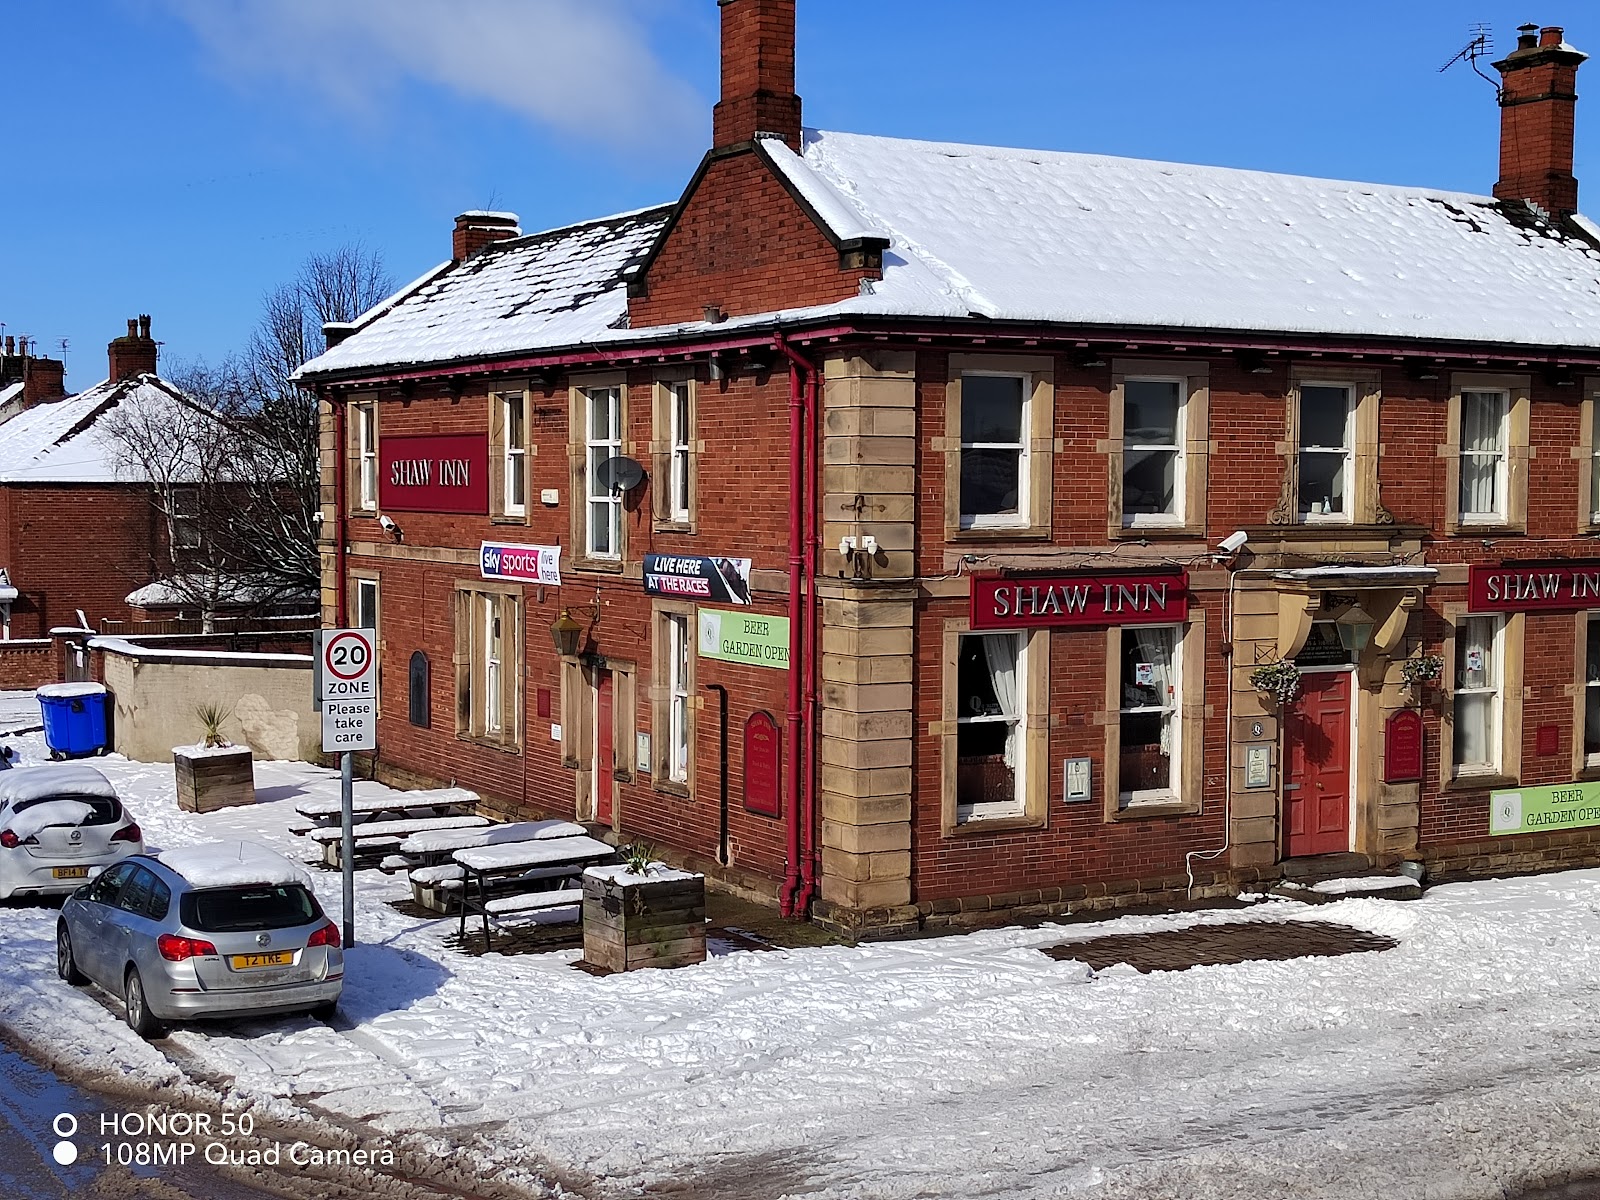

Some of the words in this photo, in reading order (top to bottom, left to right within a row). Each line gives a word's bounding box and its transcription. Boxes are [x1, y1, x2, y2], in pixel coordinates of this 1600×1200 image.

[391, 459, 433, 486] SHAW
[438, 459, 470, 487] INN
[484, 549, 500, 573] sky
[502, 553, 536, 574] sports
[541, 550, 554, 565] live
[541, 567, 558, 581] here
[653, 557, 676, 573] LIVE
[676, 559, 702, 575] HERE
[648, 576, 660, 589] AT
[661, 577, 679, 591] THE
[679, 579, 709, 594] RACES
[1487, 573, 1562, 600] SHAW
[994, 585, 1091, 616] SHAW
[1102, 582, 1168, 612] INN
[743, 620, 769, 636] BEER
[334, 645, 365, 666] 20
[723, 640, 762, 658] GARDEN
[764, 645, 790, 661] OPEN
[328, 682, 370, 694] ZONE
[328, 704, 370, 715] Please
[335, 718, 363, 729] take
[335, 733, 363, 743] care
[1551, 789, 1583, 803] BEER
[1526, 809, 1576, 825] GARDEN
[58, 868, 76, 877] BF14
[244, 955, 259, 966] T2
[263, 953, 282, 965] TKE
